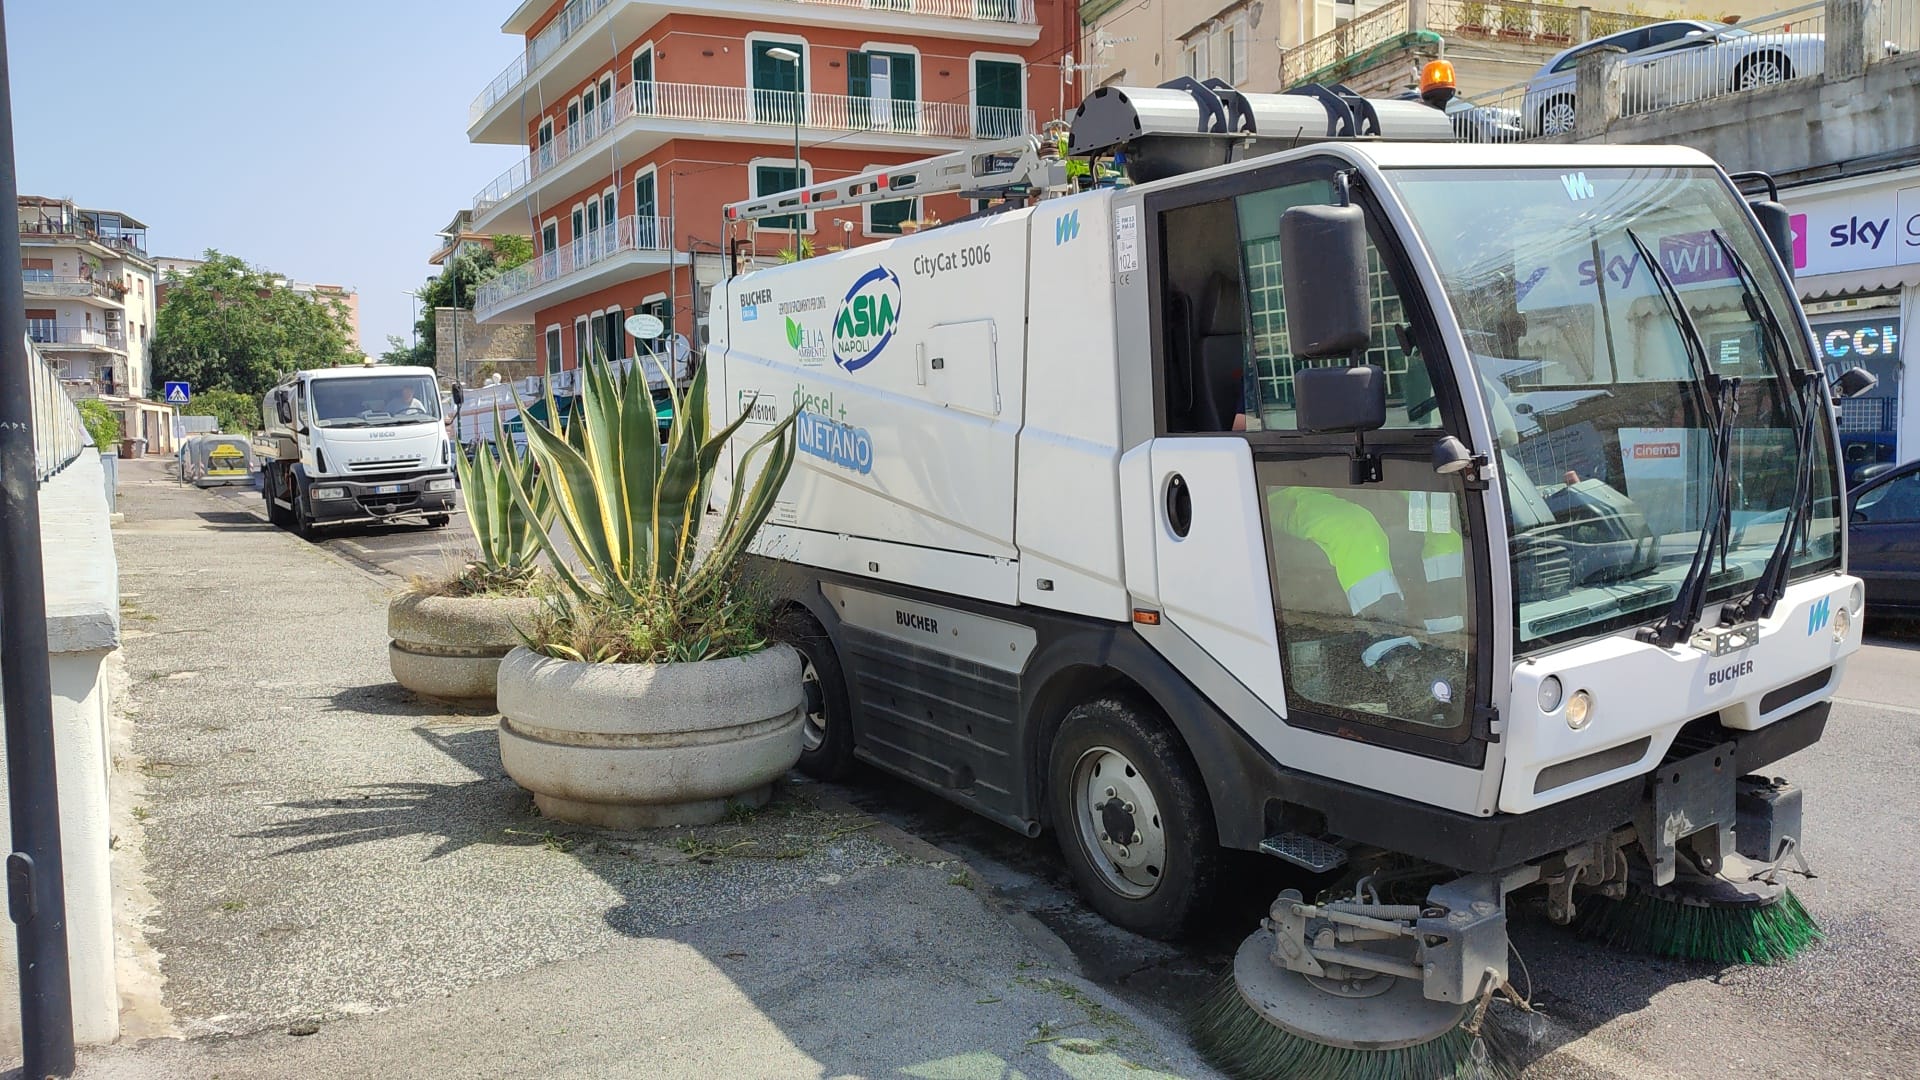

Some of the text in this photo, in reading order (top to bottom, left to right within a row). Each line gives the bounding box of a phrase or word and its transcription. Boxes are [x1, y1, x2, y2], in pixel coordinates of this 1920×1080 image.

[1829, 215, 1891, 250] sky
[913, 243, 992, 279] CityCat 5006
[1119, 253, 1131, 270] 102
[1578, 249, 1640, 290] sky
[740, 288, 773, 307] BUCHER
[836, 292, 895, 340] ASIA
[838, 339, 870, 353] NAPOLI
[793, 383, 834, 418] diesel
[369, 431, 396, 439] IVECO
[800, 416, 870, 466] METANO
[1635, 444, 1679, 457] cinema
[895, 609, 939, 635] BUCHER
[1708, 660, 1754, 687] BUCHER
